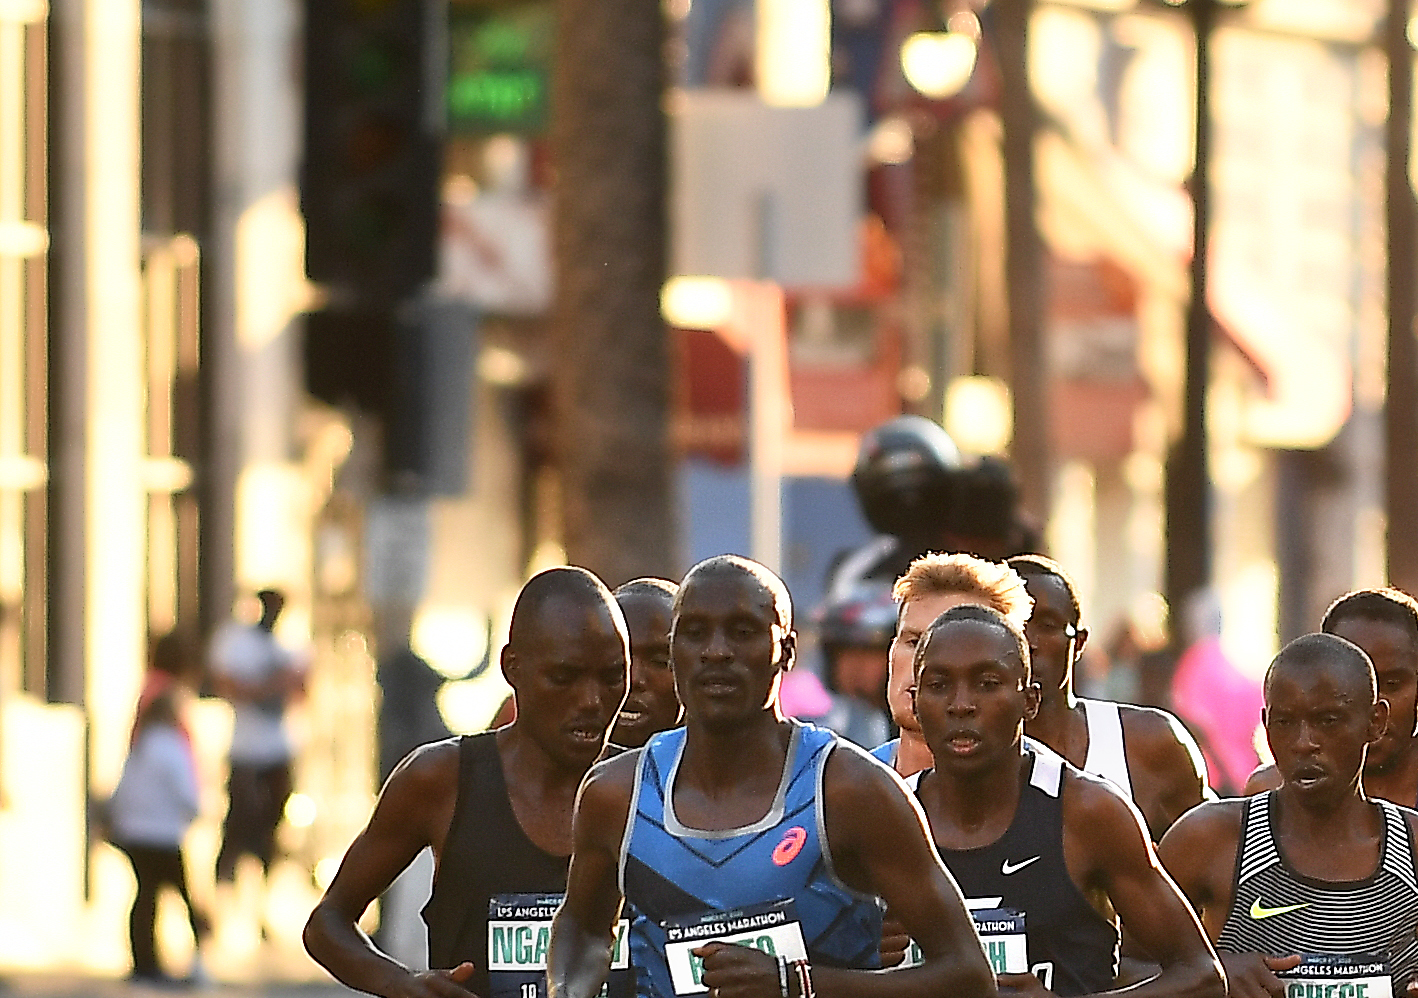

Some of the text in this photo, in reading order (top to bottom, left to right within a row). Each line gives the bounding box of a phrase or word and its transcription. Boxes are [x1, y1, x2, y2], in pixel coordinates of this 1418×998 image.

[497, 907, 556, 918] LOS ANGELE
[684, 923, 727, 938] ANGELES
[728, 911, 786, 932] MARATHON
[975, 920, 1015, 932] RATHON
[1333, 963, 1383, 976] MARATHON
